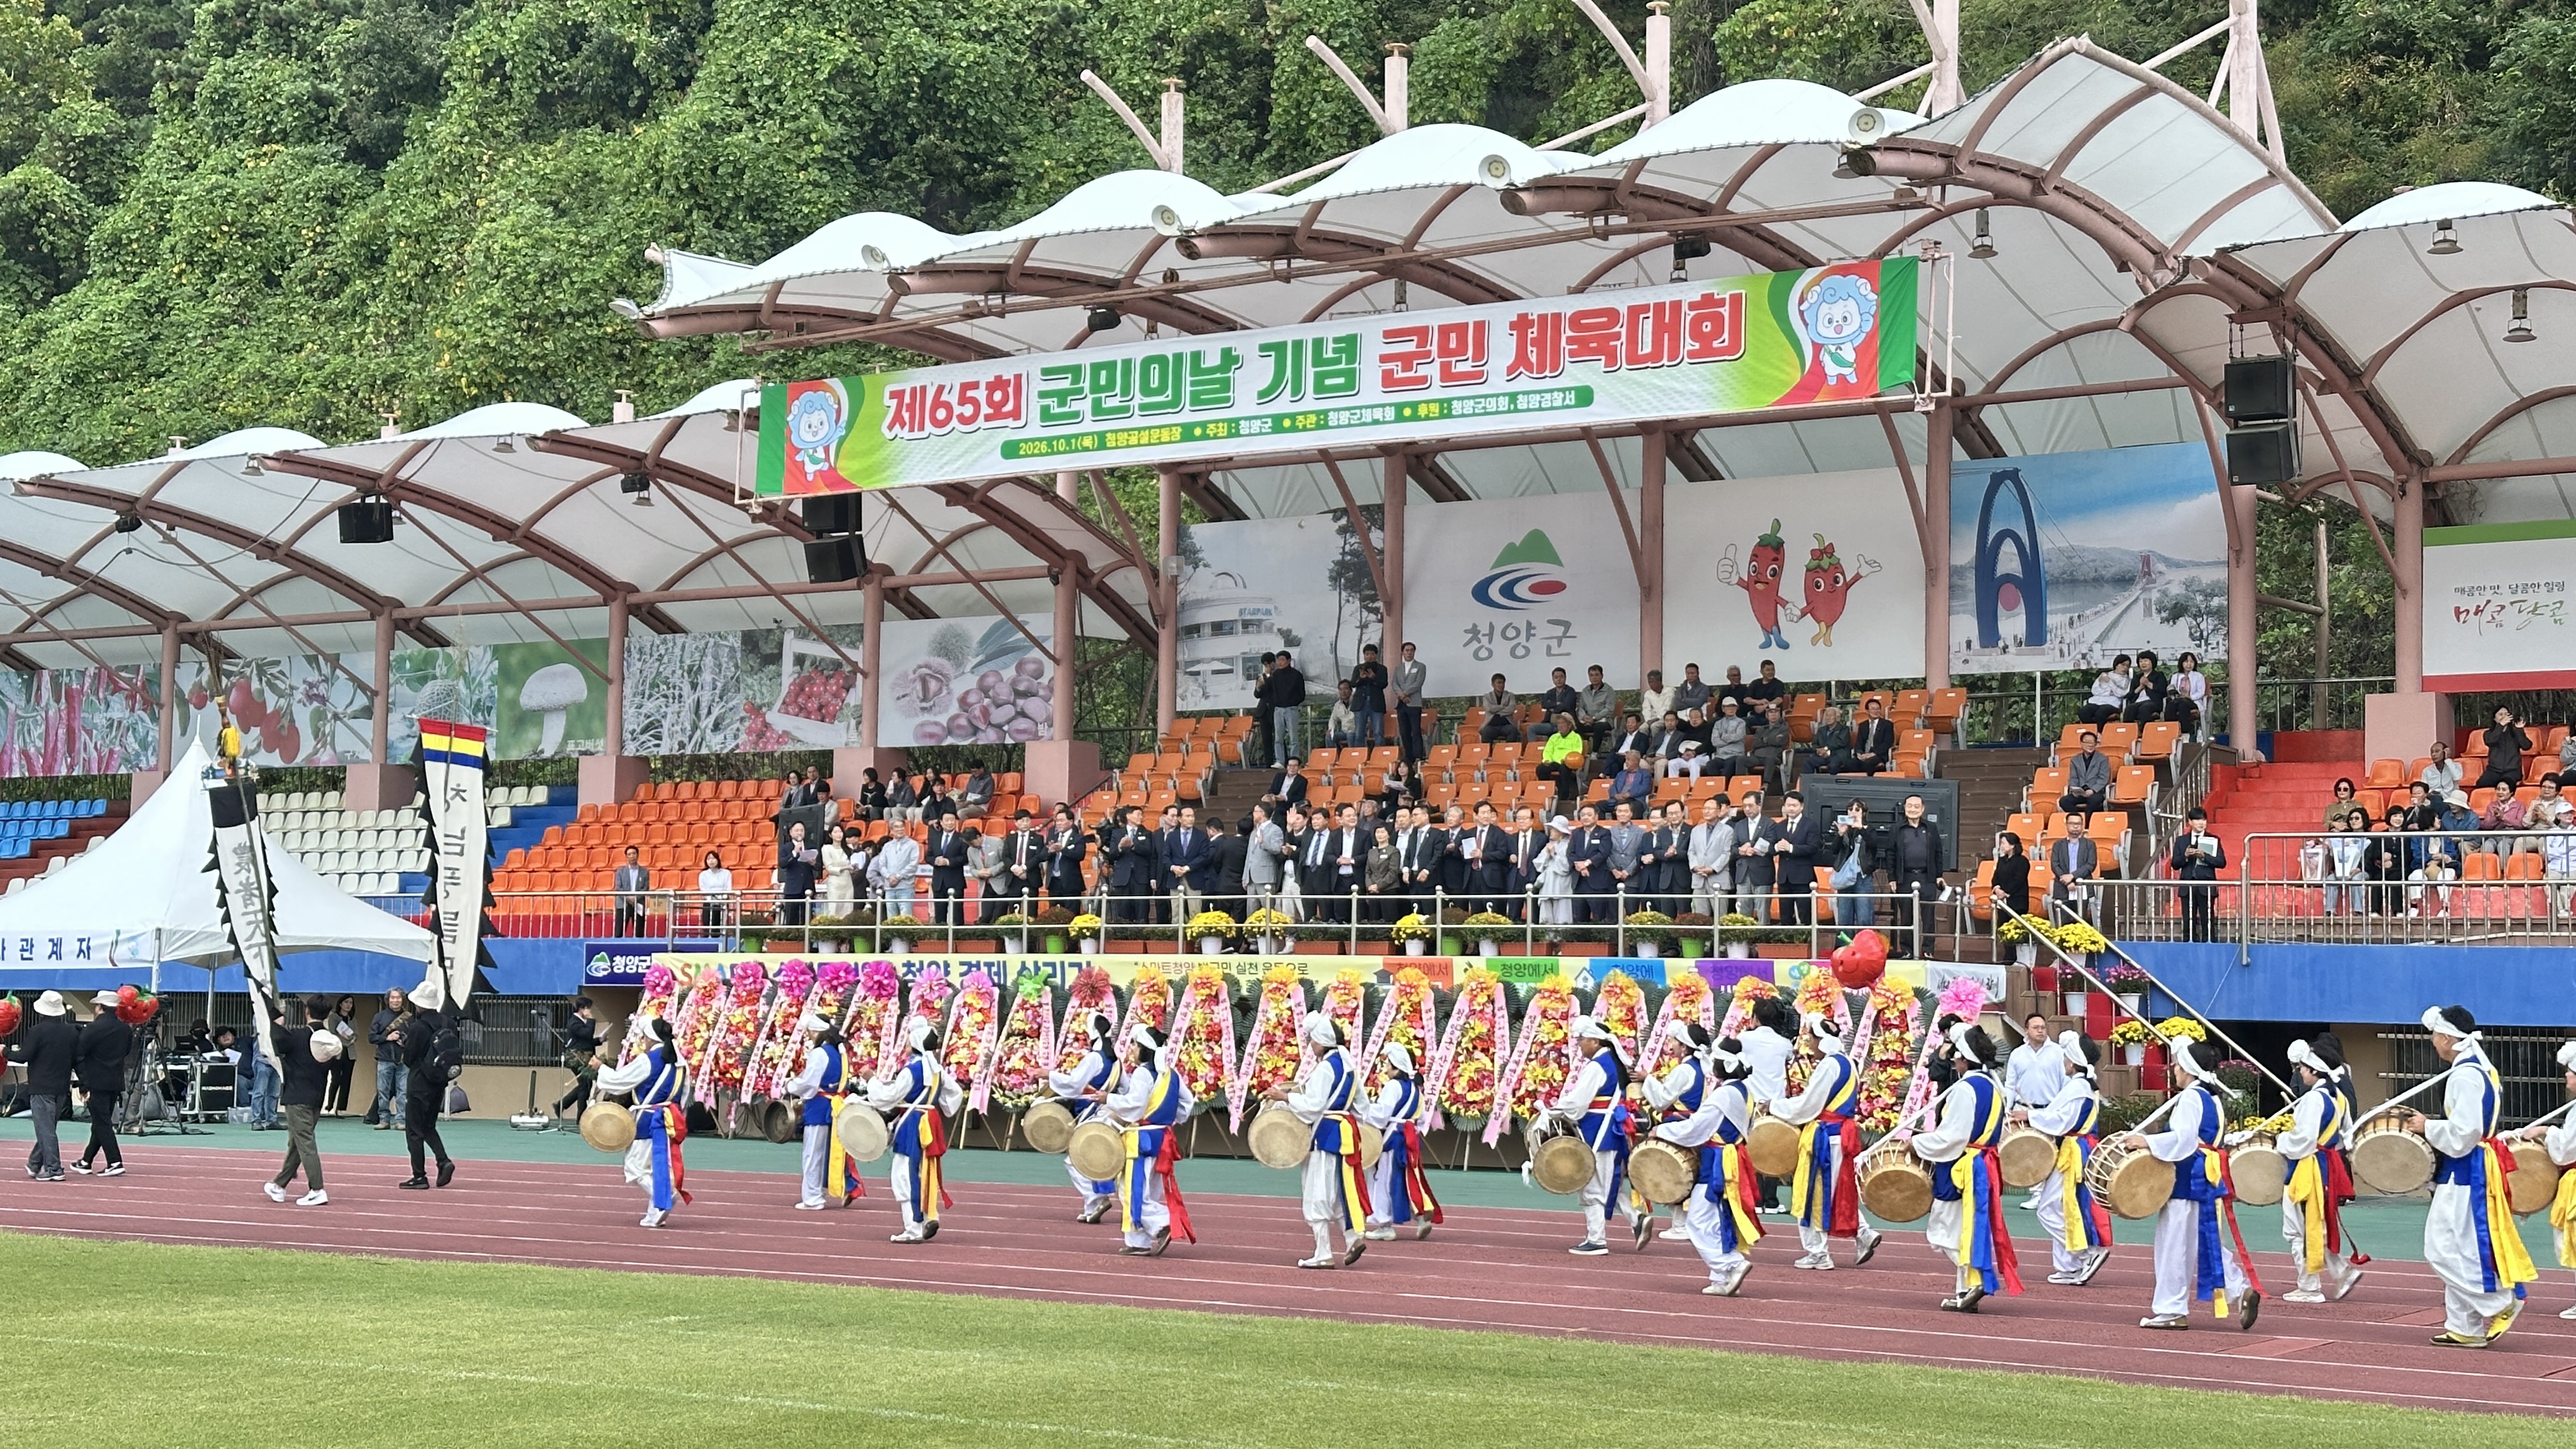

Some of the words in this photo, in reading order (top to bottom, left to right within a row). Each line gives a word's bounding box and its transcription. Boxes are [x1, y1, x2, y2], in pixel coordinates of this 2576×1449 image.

[885, 371, 1023, 434] 제65회
[1036, 345, 1241, 424] 군민의날
[1256, 332, 1361, 403] 기념
[1378, 319, 1488, 390] 군민
[1505, 291, 1745, 381] 체육대회
[1018, 434, 1098, 456] 2026.10.1(목)
[1105, 426, 1181, 448] 청양공설운동장
[1206, 422, 1227, 437] 주최
[1238, 418, 1273, 435] 청양군
[1294, 413, 1317, 429] 주관
[1327, 406, 1395, 426] 청양군체육회
[1417, 402, 1440, 418] 후원
[1516, 390, 1575, 410] 청양경찰서
[1462, 618, 1577, 661] 청양군
[613, 954, 651, 973] 청양군
[1236, 962, 1258, 975] 실천
